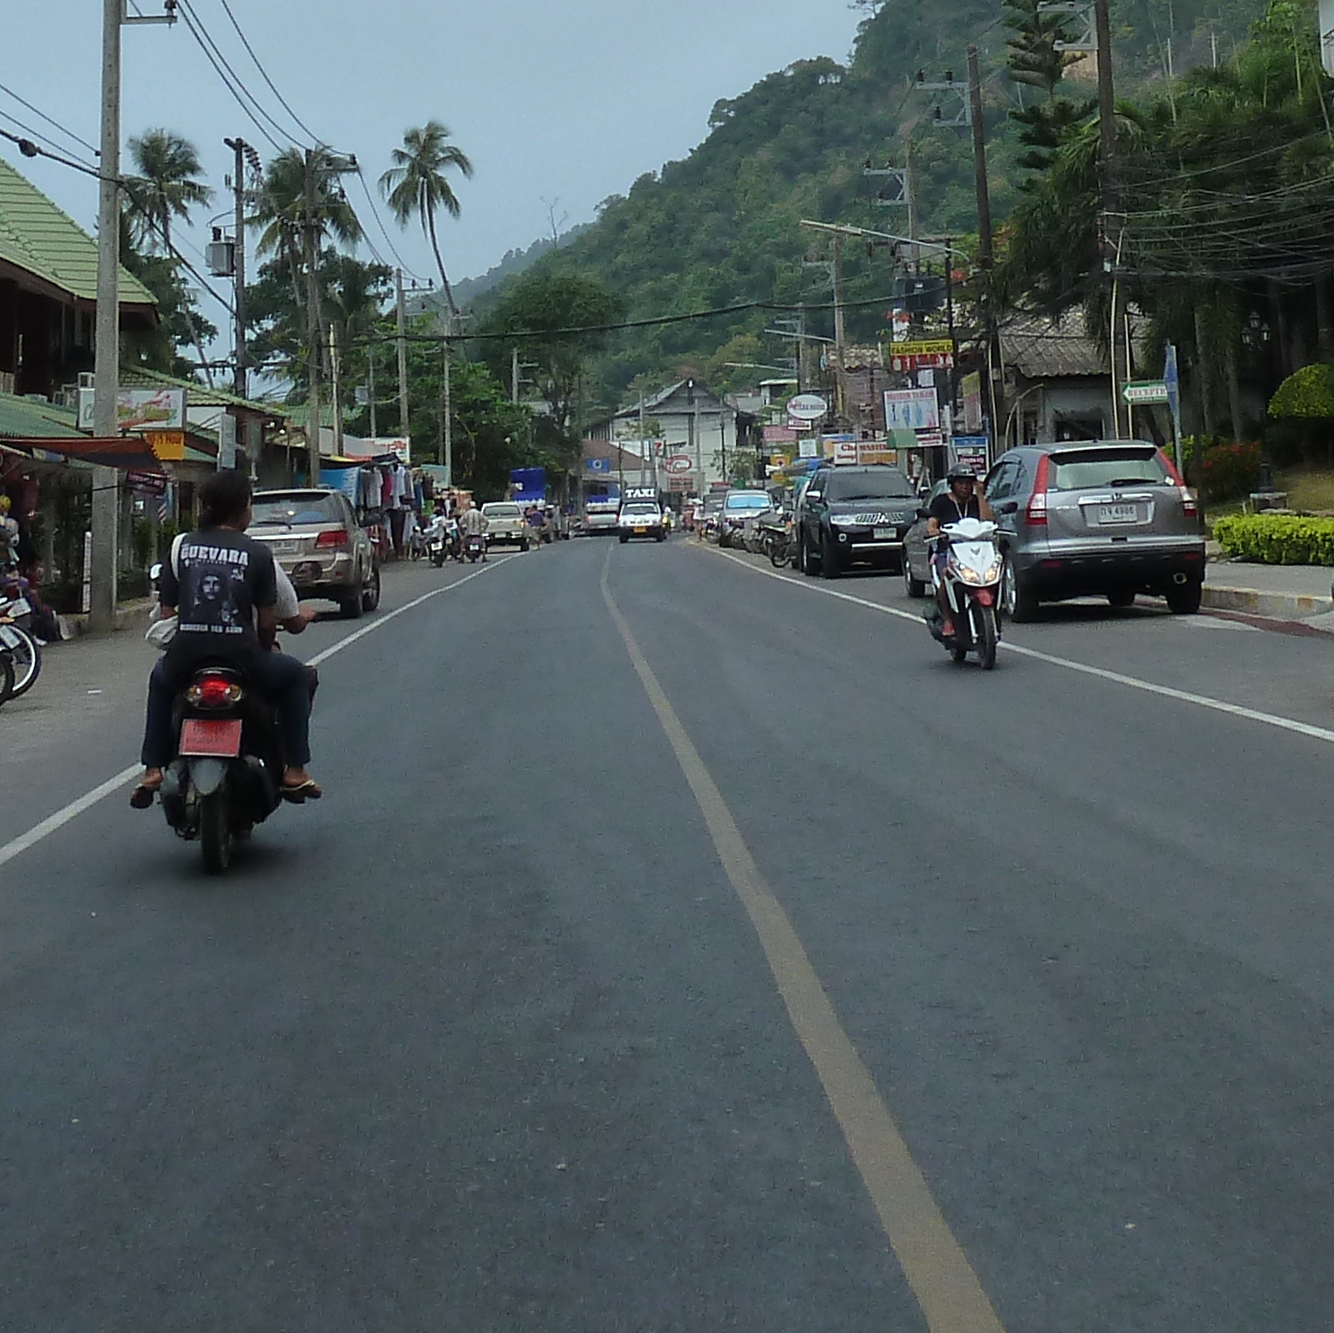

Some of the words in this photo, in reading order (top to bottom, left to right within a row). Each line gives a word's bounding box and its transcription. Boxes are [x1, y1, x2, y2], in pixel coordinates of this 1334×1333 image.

[891, 346, 923, 354] FASHION
[926, 345, 953, 353] WORLD
[625, 488, 655, 498] TAXI
[180, 545, 249, 566] GUEVARA
